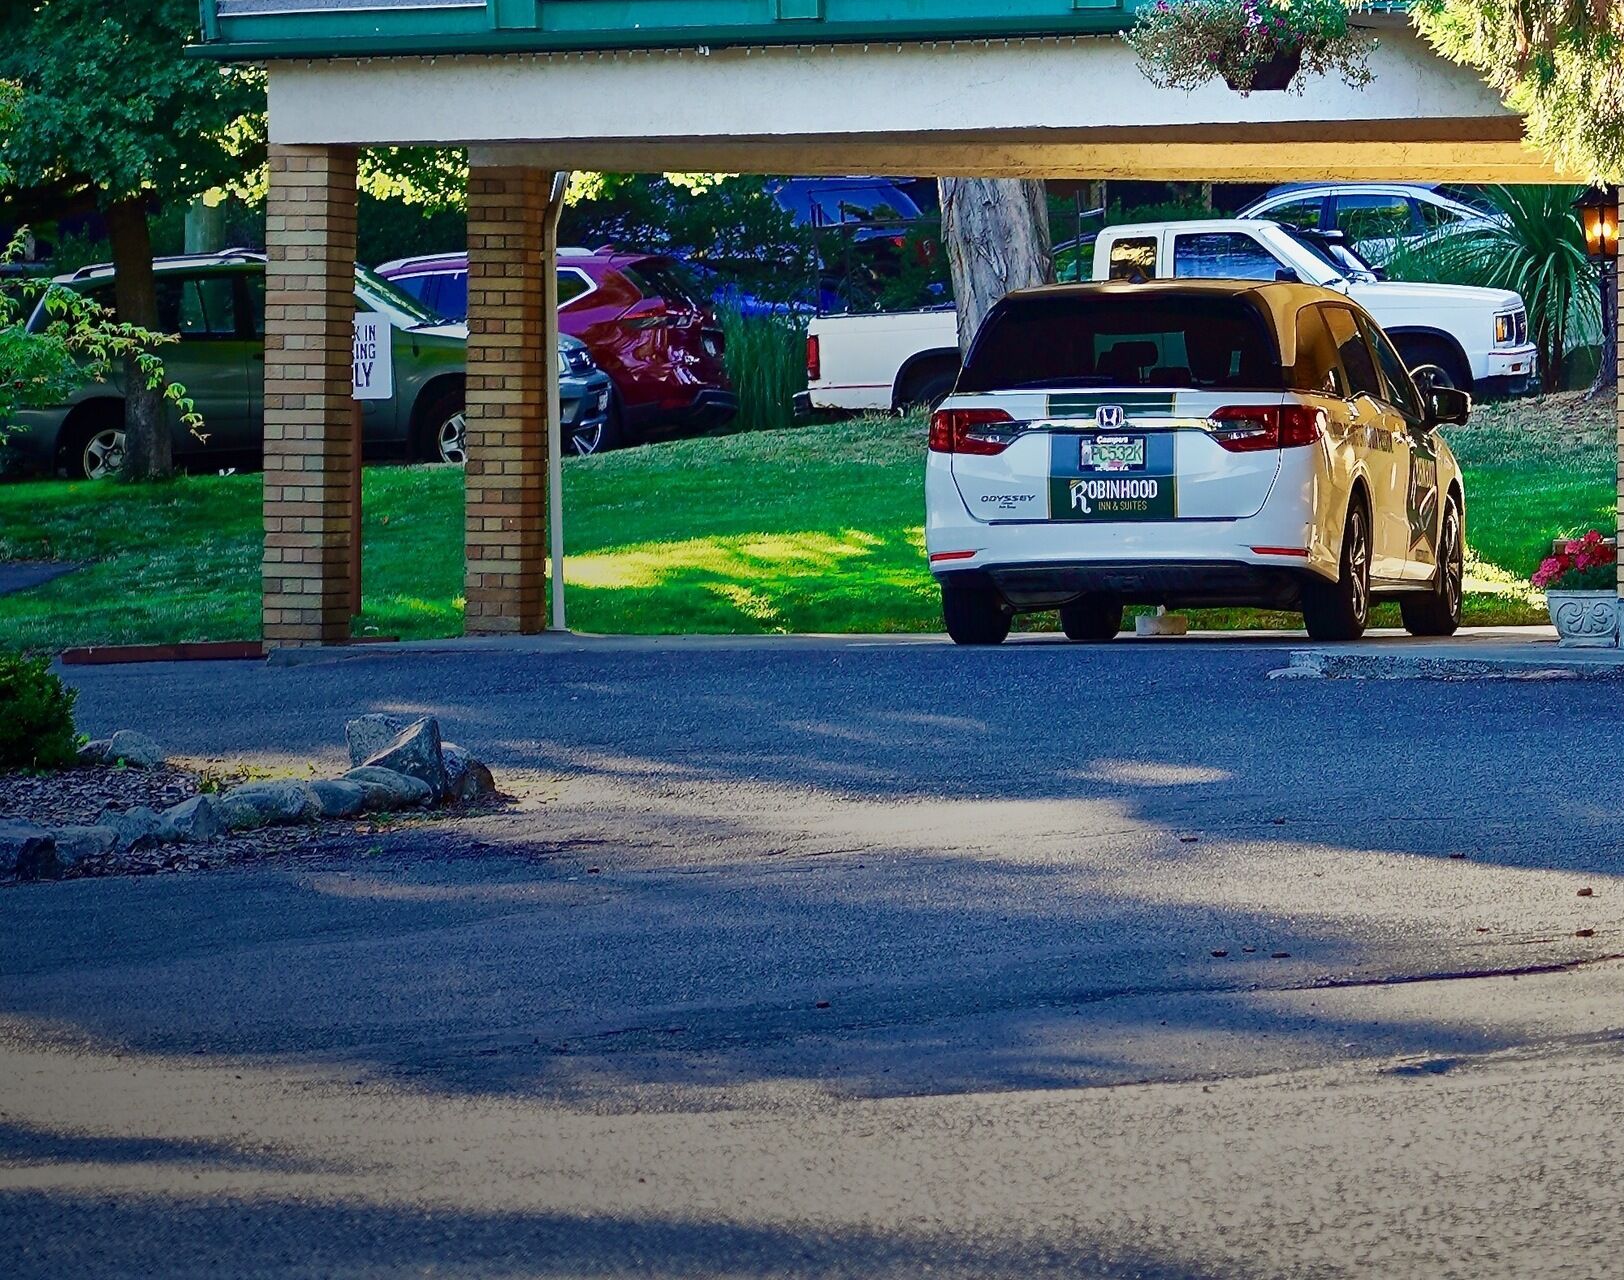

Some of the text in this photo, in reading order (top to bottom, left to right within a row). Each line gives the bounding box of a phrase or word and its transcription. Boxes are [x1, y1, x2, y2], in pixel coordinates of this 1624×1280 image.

[365, 325, 376, 341] IN
[354, 343, 376, 359] ING
[354, 362, 373, 388] LY
[1070, 479, 1158, 514] ROBINHOOD
[1098, 500, 1147, 510] INN & SUITES
